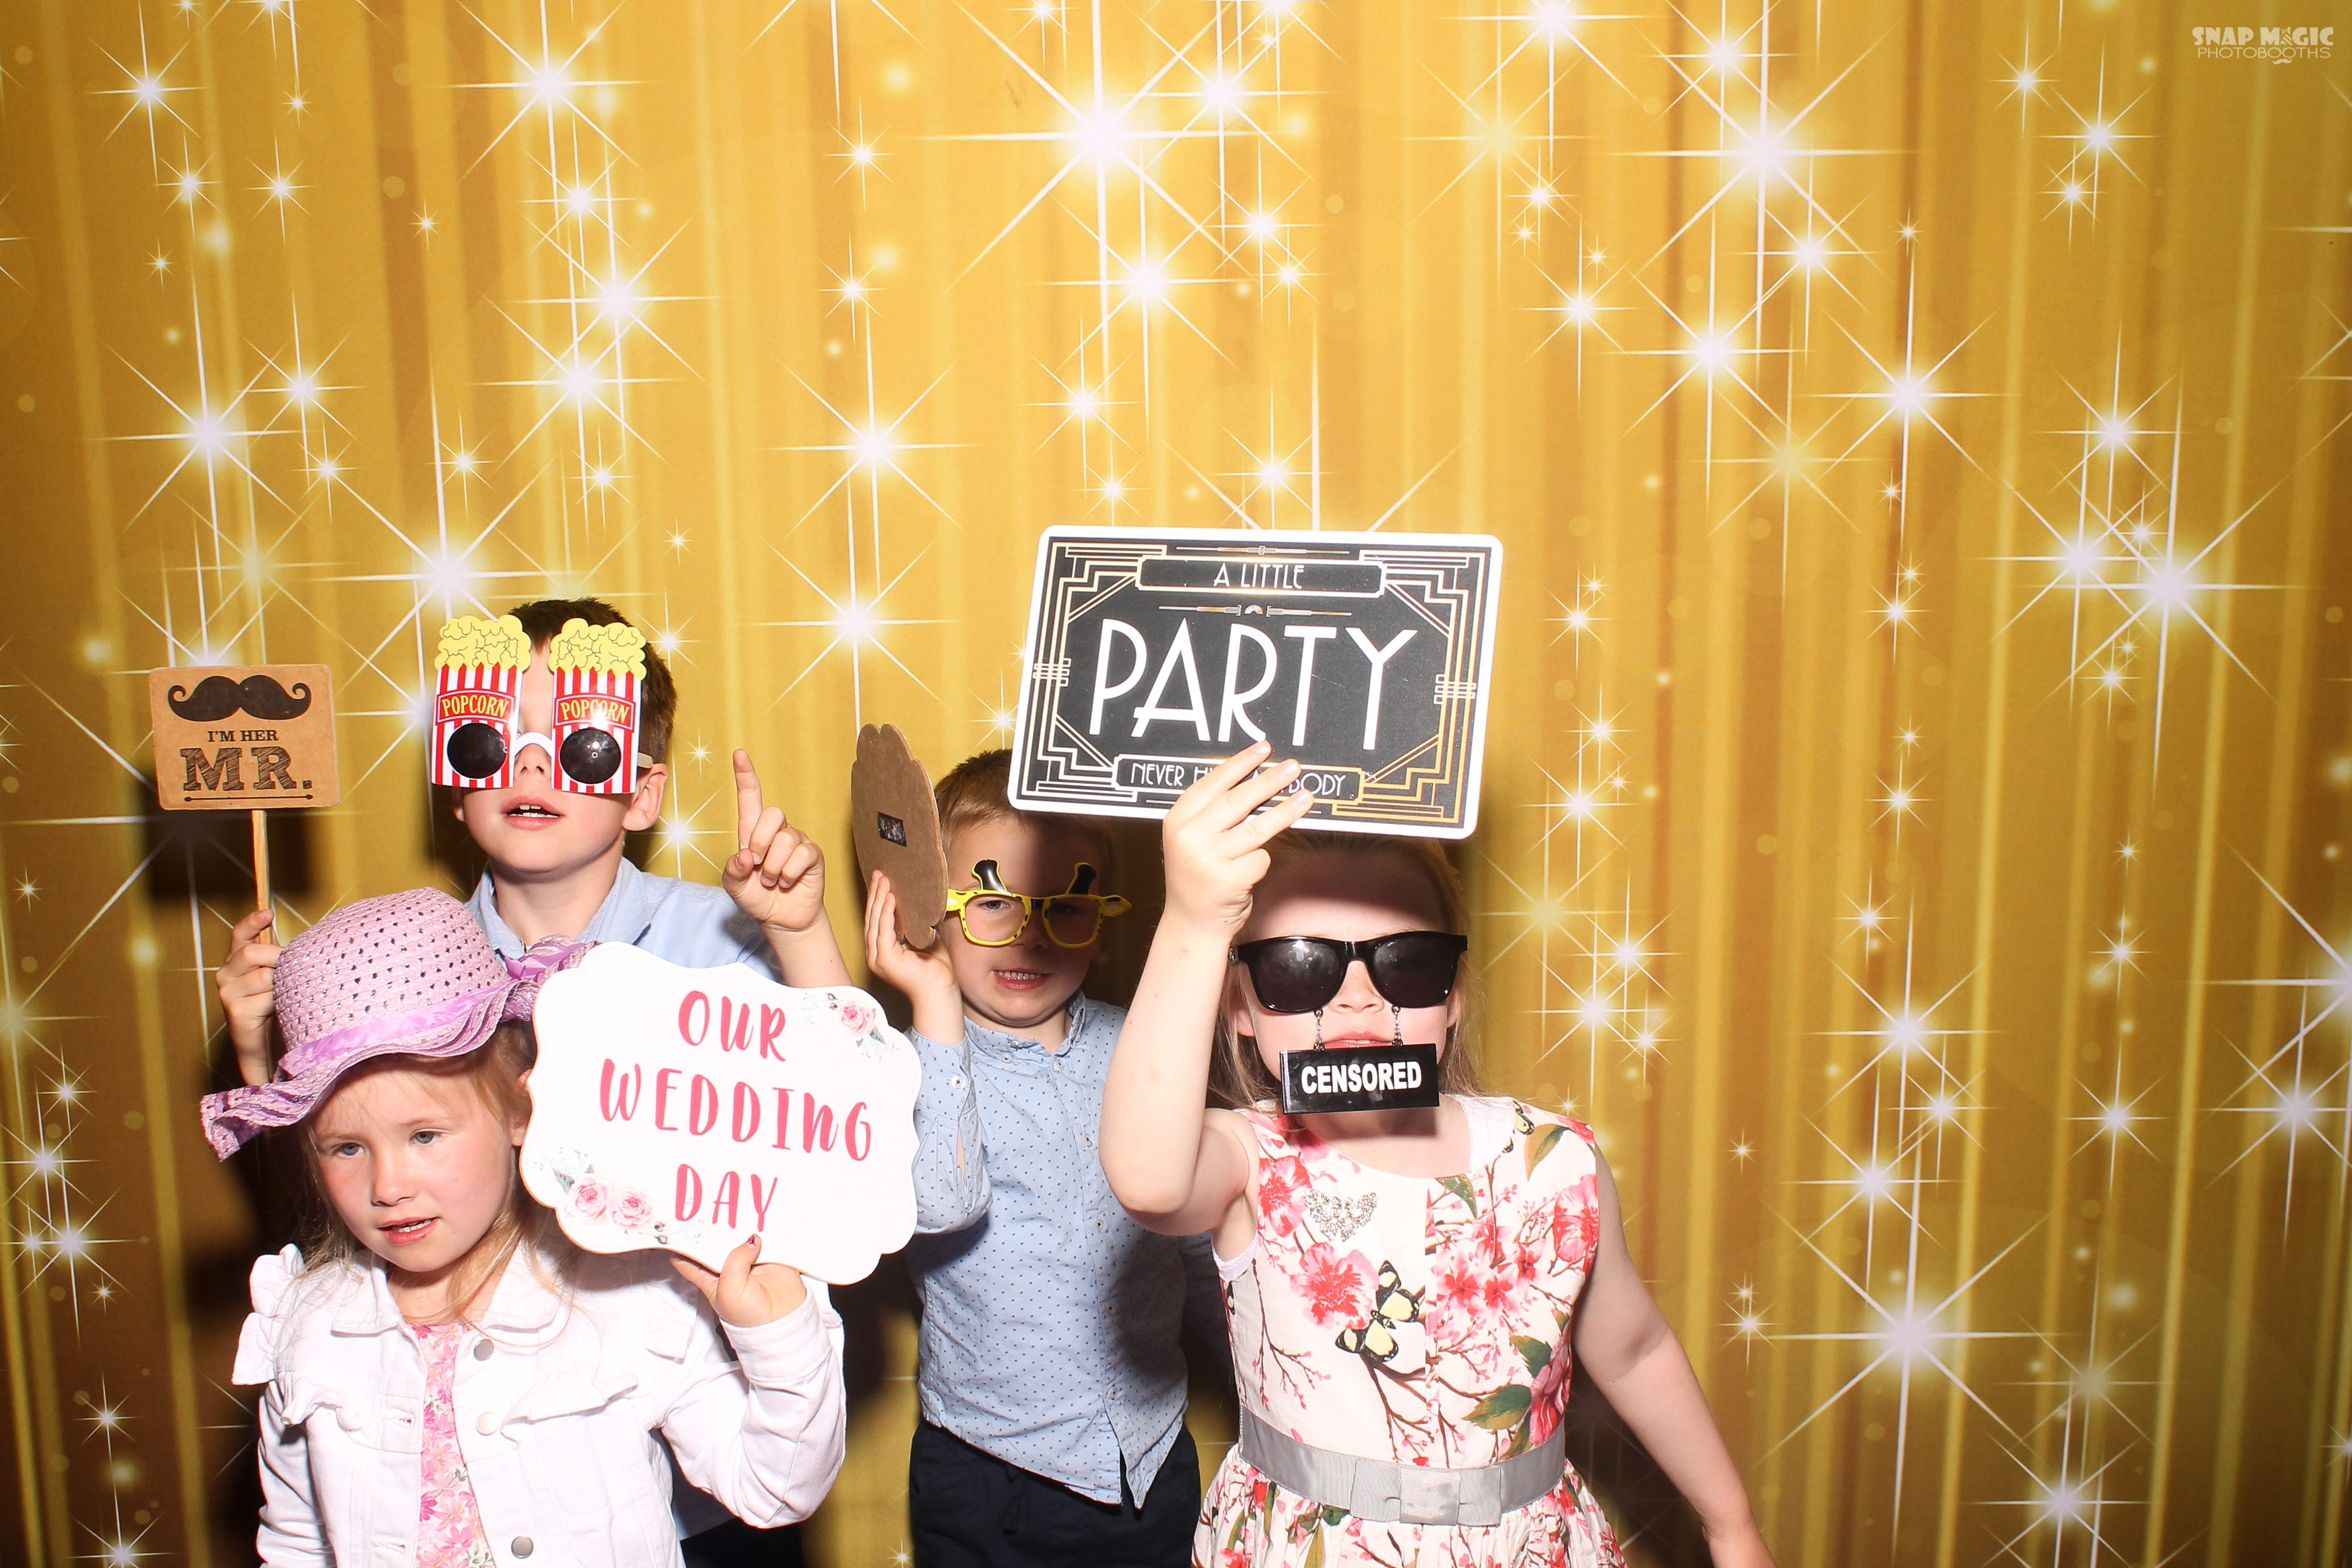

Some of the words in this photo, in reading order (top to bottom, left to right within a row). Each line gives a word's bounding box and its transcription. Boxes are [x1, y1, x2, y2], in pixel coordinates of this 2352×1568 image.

[1213, 562, 1230, 587] A
[1240, 564, 1305, 589] LITTLE
[1089, 617, 1418, 750] PARTY
[442, 695, 509, 718] POPCORN
[560, 699, 630, 724] POPCORN
[208, 730, 236, 742] I'M
[240, 730, 279, 742] HER
[180, 746, 313, 791] MR.
[1131, 763, 1185, 787] NEVER
[678, 990, 786, 1062] OUR
[1301, 1061, 1422, 1094] CENSORED
[600, 1058, 871, 1161] WEDDING
[675, 1163, 778, 1232] DAY
